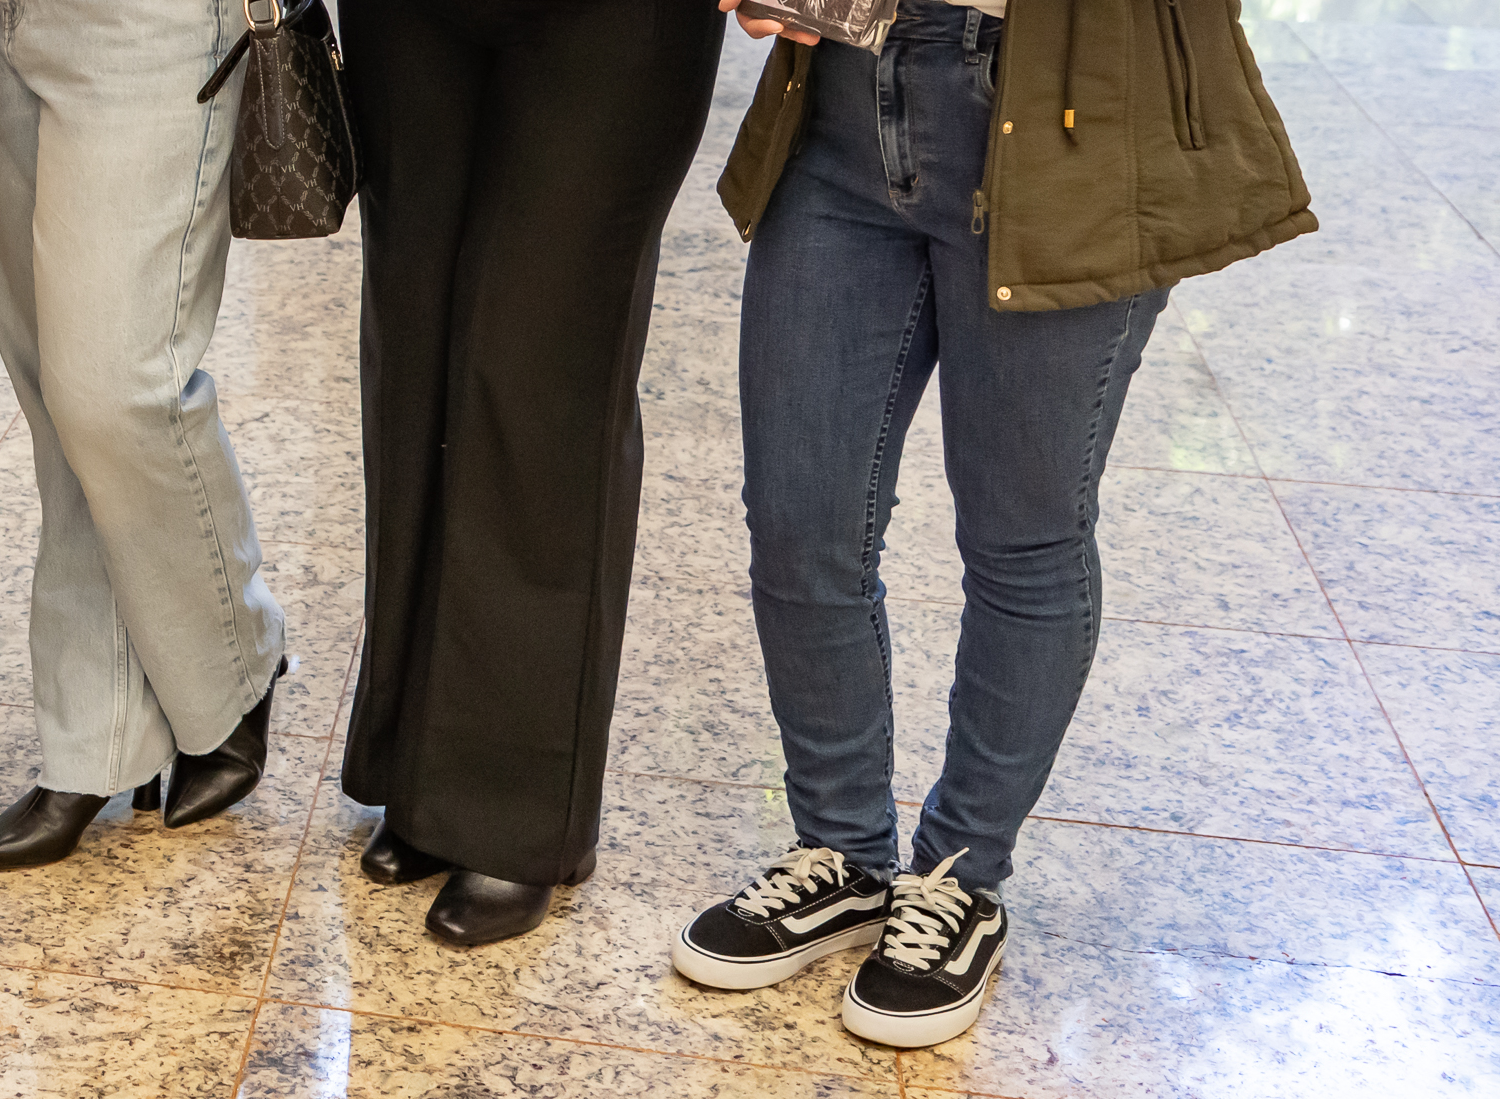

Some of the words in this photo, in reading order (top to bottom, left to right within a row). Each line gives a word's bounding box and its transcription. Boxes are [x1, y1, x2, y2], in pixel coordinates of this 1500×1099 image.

[286, 102, 300, 110] VH
[295, 140, 308, 149] VH
[281, 165, 295, 173] VH
[304, 179, 318, 188] VH
[256, 204, 270, 212] VH
[290, 203, 304, 211] VH
[312, 217, 327, 226] VH
